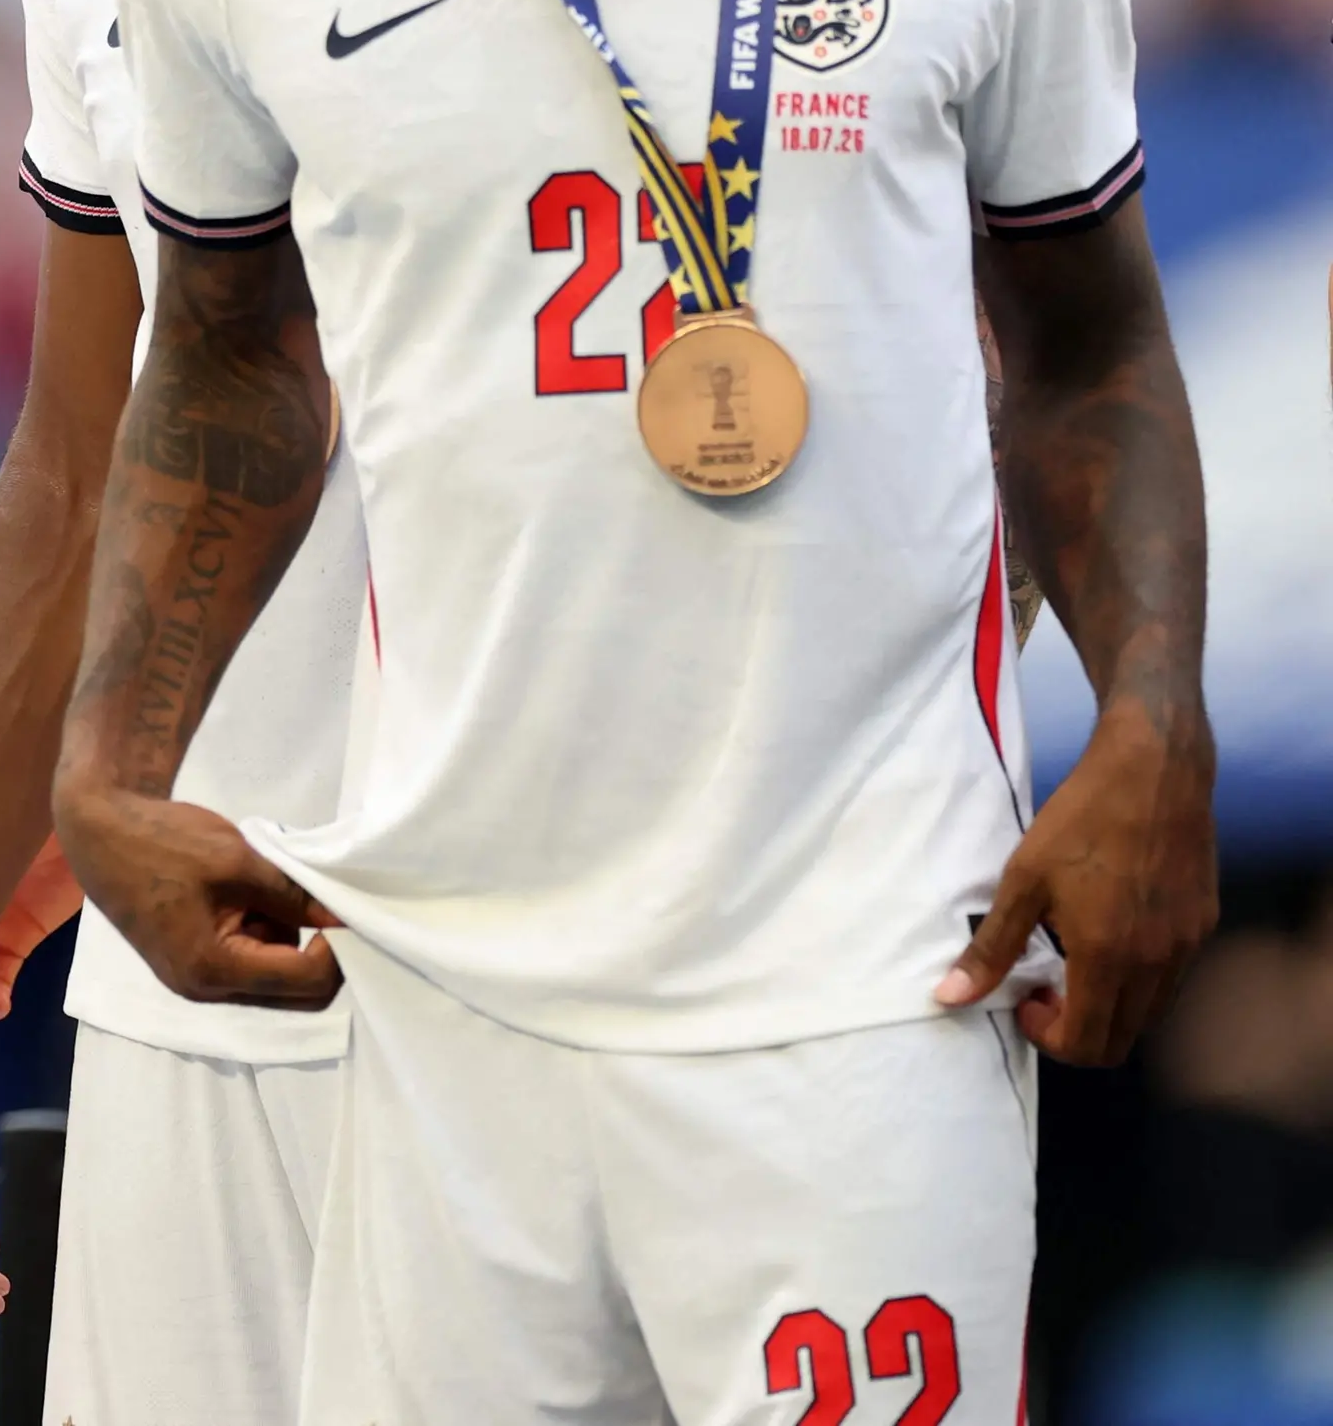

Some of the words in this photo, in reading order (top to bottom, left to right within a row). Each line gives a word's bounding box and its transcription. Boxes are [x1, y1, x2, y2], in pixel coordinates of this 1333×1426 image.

[729, 21, 760, 90] FIFA
[775, 92, 870, 120] FRANCE
[780, 127, 865, 155] 18.07.26
[763, 1293, 962, 1426] 22
